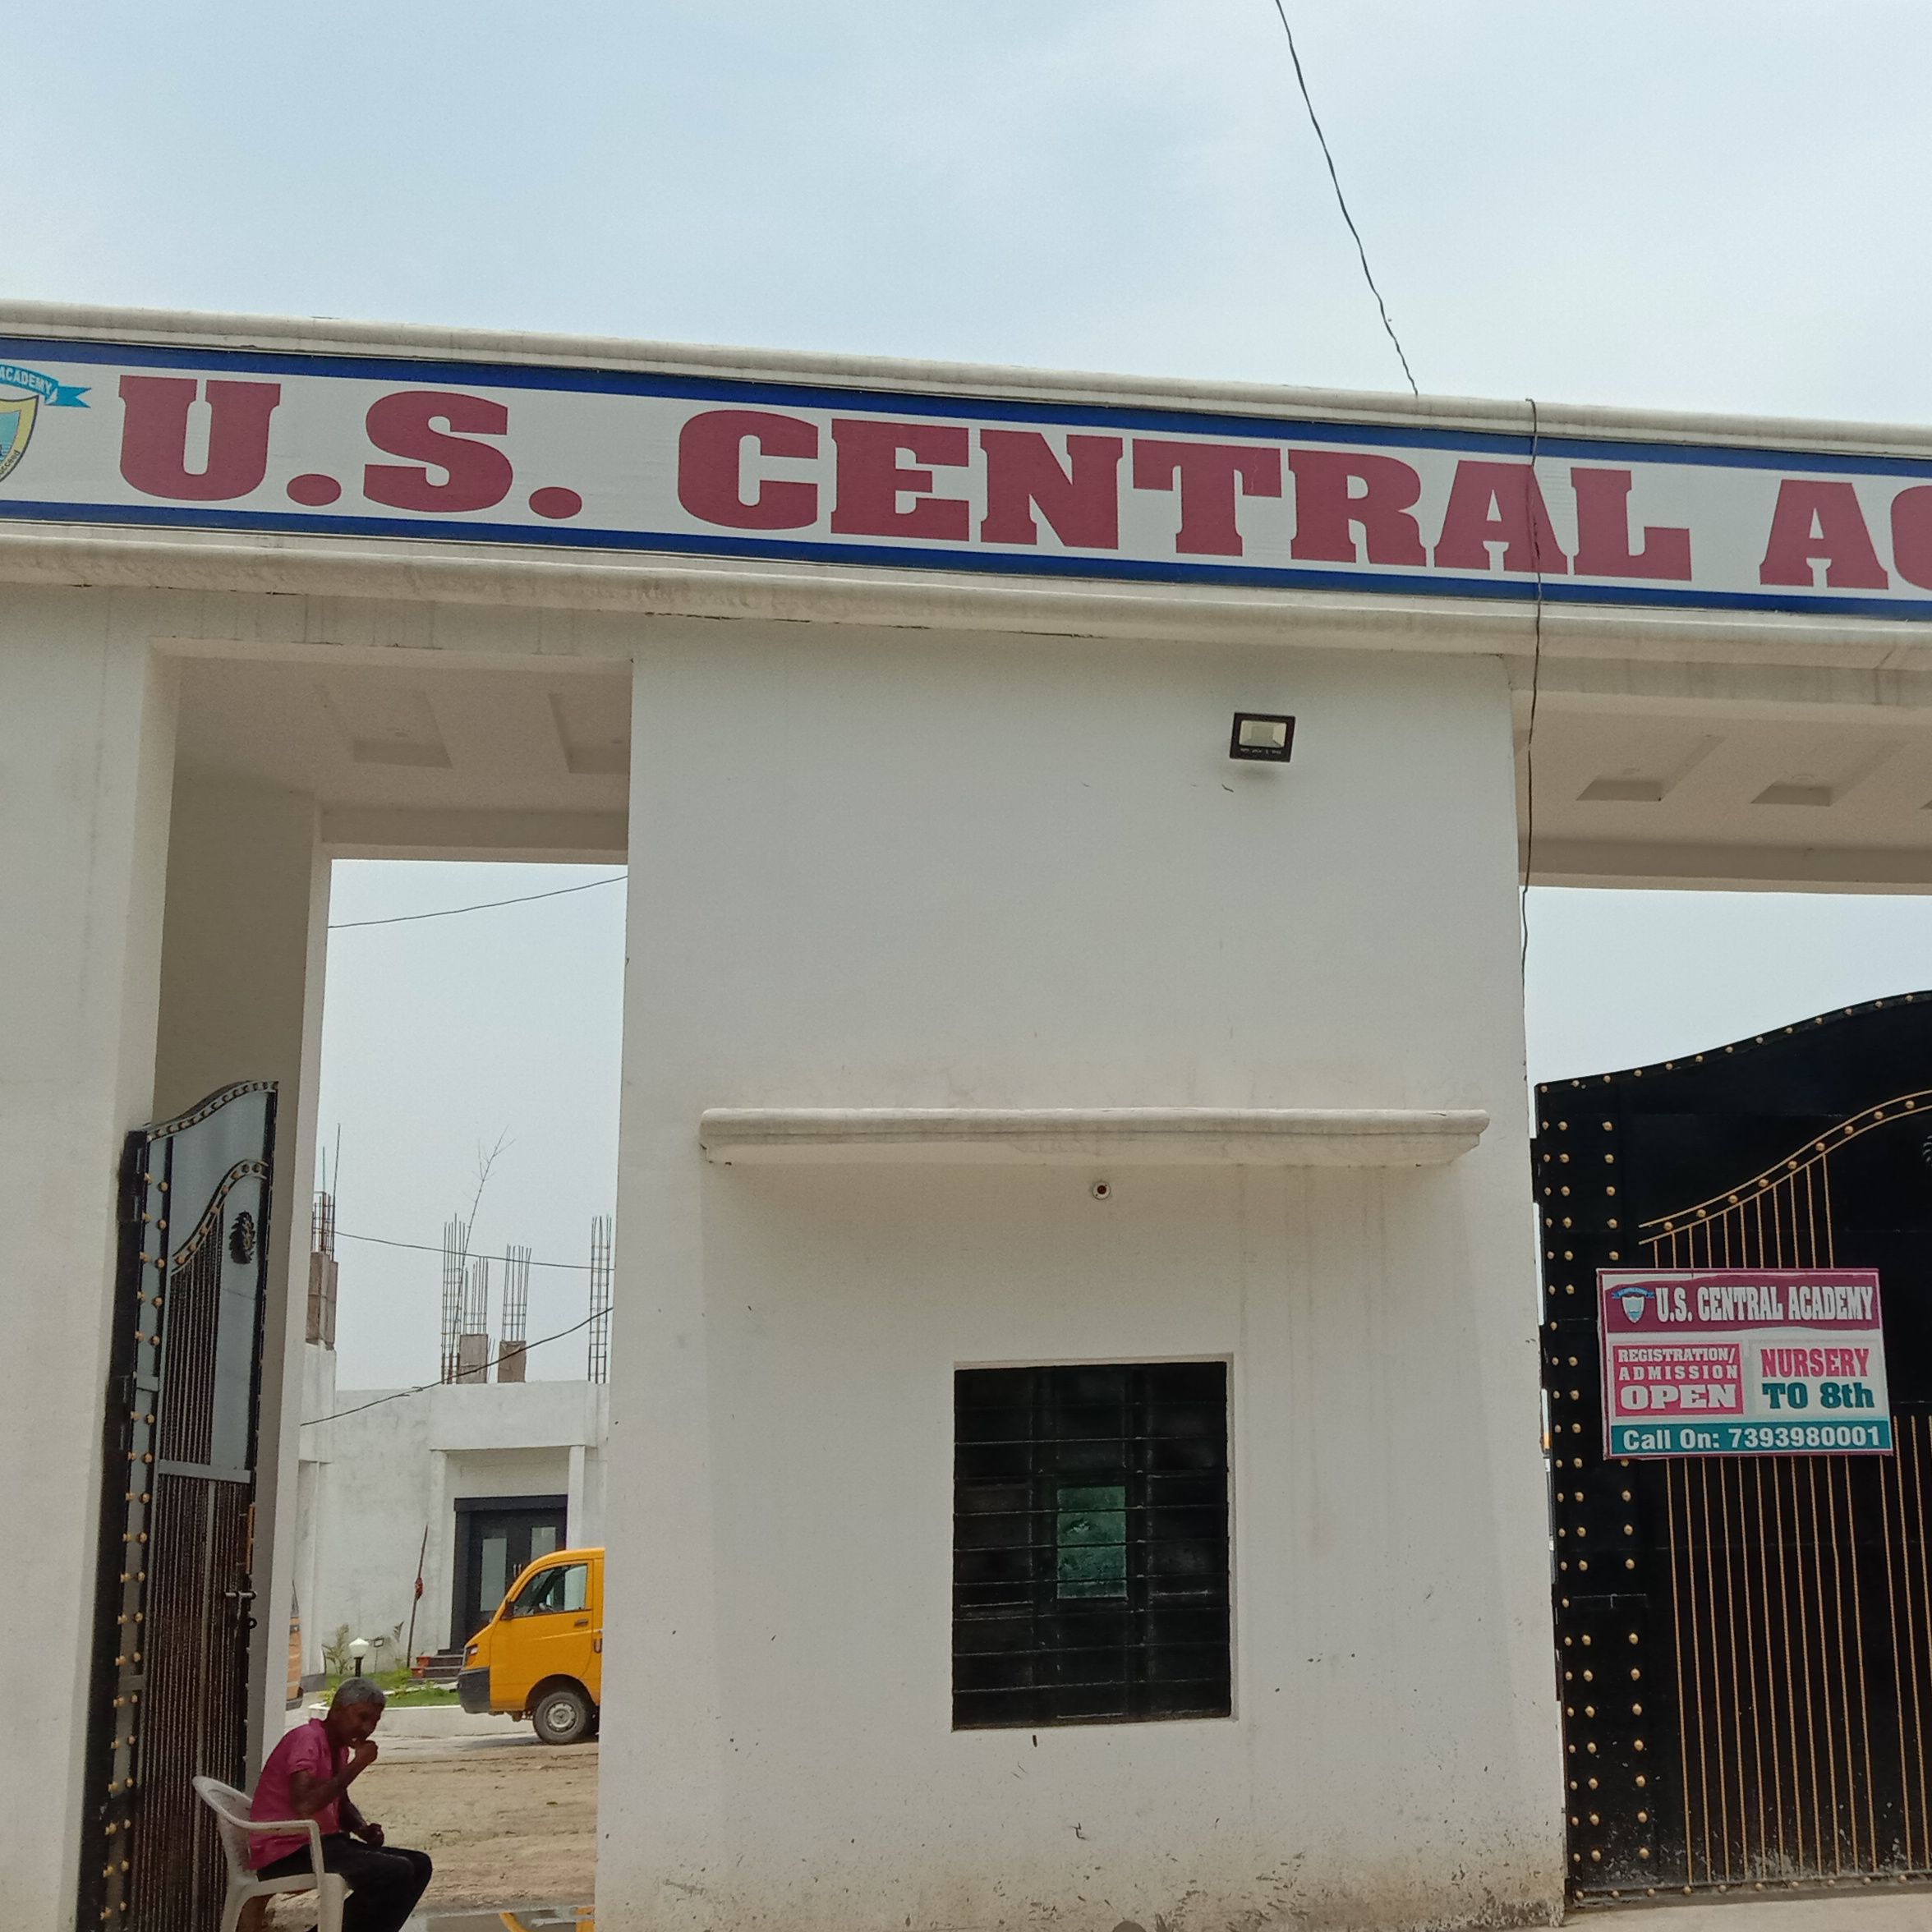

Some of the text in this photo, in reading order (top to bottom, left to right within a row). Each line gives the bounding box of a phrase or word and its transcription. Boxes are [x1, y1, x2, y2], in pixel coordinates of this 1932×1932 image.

[118, 375, 1932, 590] U.S. CENTRAL A
[1655, 1286, 1873, 1322] U.S. CENTRAL ACADEMY
[1617, 1348, 1736, 1364] REGISTRATION/
[1760, 1348, 1869, 1378] NURSERY
[1619, 1364, 1738, 1381] ADMISSION
[1620, 1384, 1736, 1410] OPEN
[1762, 1382, 1874, 1410] TO 8th
[1623, 1426, 1879, 1451] Call On: 7393980001
